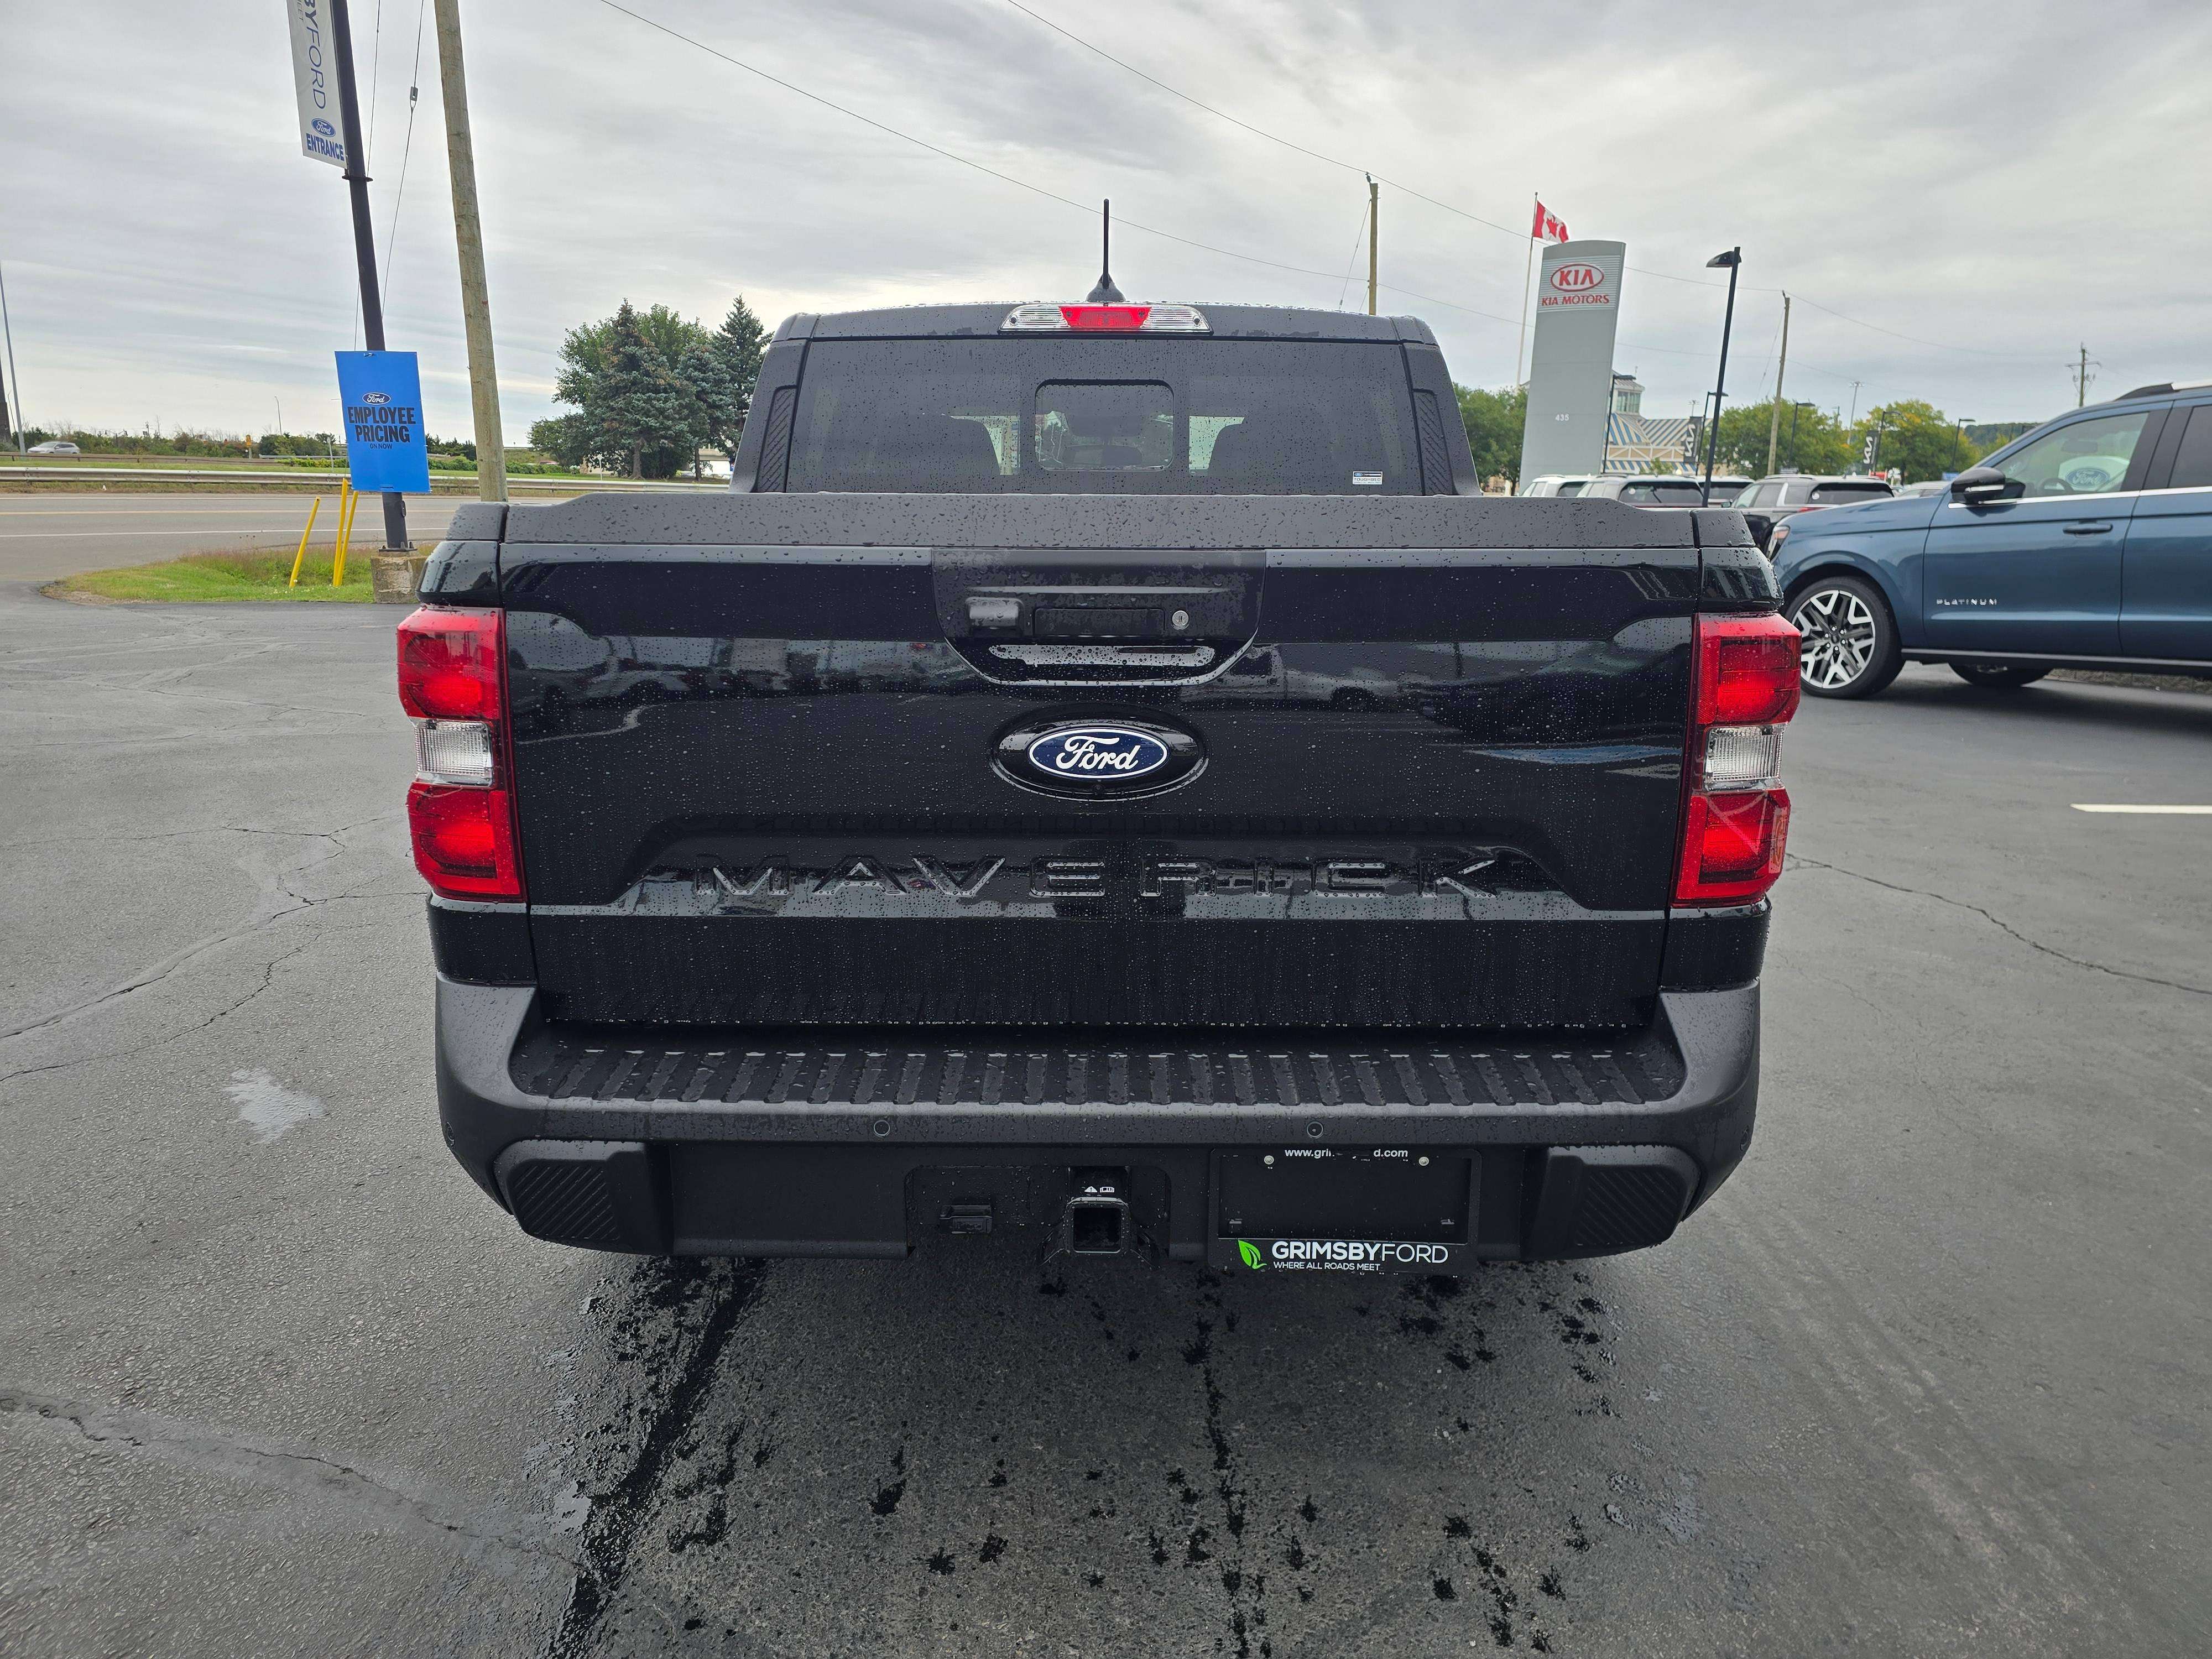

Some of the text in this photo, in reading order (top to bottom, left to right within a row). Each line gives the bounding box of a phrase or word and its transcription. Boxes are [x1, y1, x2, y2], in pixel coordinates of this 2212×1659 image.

[306, 133, 345, 161] ENTRANCE
[1559, 269, 1594, 286] KIA
[1542, 296, 1558, 306] KIA
[1562, 295, 1609, 305] MOTORS
[348, 406, 416, 424] EMPLOYEE
[355, 425, 410, 442] PRICING
[1056, 735, 1141, 770] Ford
[695, 854, 1496, 898] MAVERICK
[1272, 1241, 1448, 1263] GRIMSBYFORD
[1357, 1263, 1380, 1271] MEET
